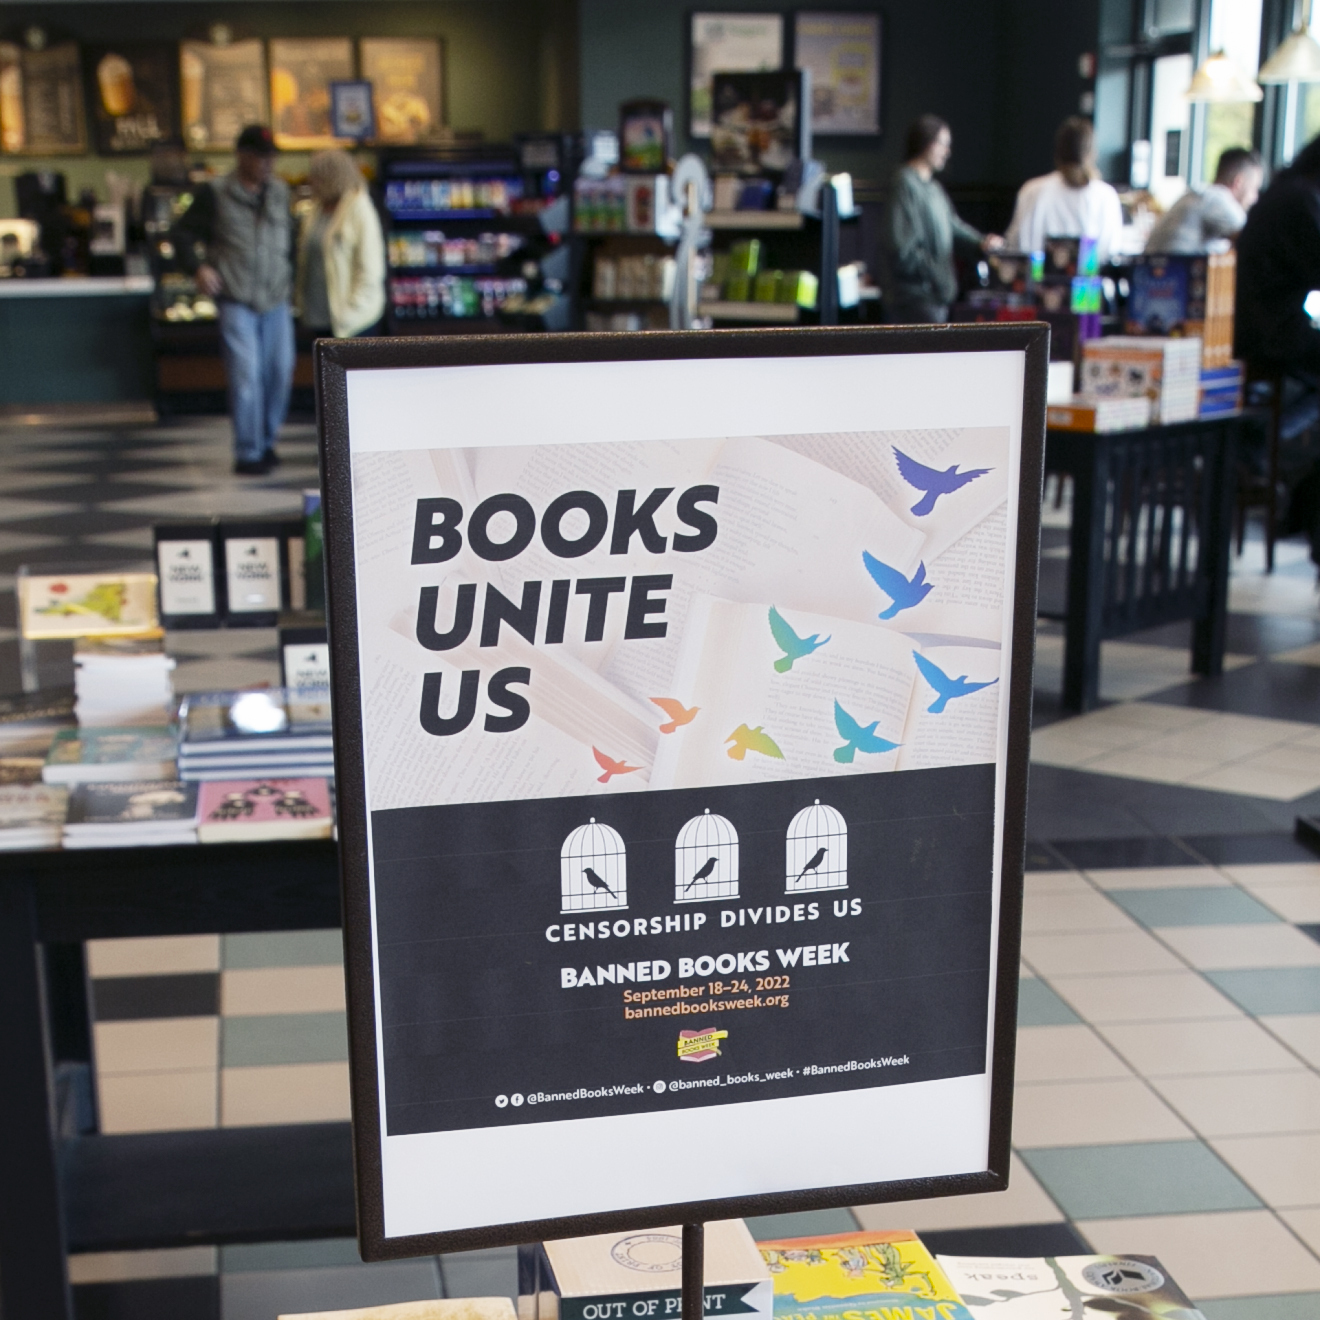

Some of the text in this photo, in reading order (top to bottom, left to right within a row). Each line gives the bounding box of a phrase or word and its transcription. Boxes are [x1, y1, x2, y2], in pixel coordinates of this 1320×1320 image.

[411, 485, 720, 565] BOOKS
[415, 574, 674, 652] UNITE
[419, 666, 532, 737] US
[545, 898, 863, 943] CENSORSHIP DIVIDES US
[560, 942, 851, 989] BANNED BOOKS WEEK
[623, 983, 706, 1004] September
[755, 975, 791, 991] 2022
[623, 992, 790, 1020] bannedbooksweek.org
[526, 1054, 911, 1105] @BannedBooksWeek @banned_books_week #BannedBooksWeek
[582, 1299, 659, 1320] OUT OF
